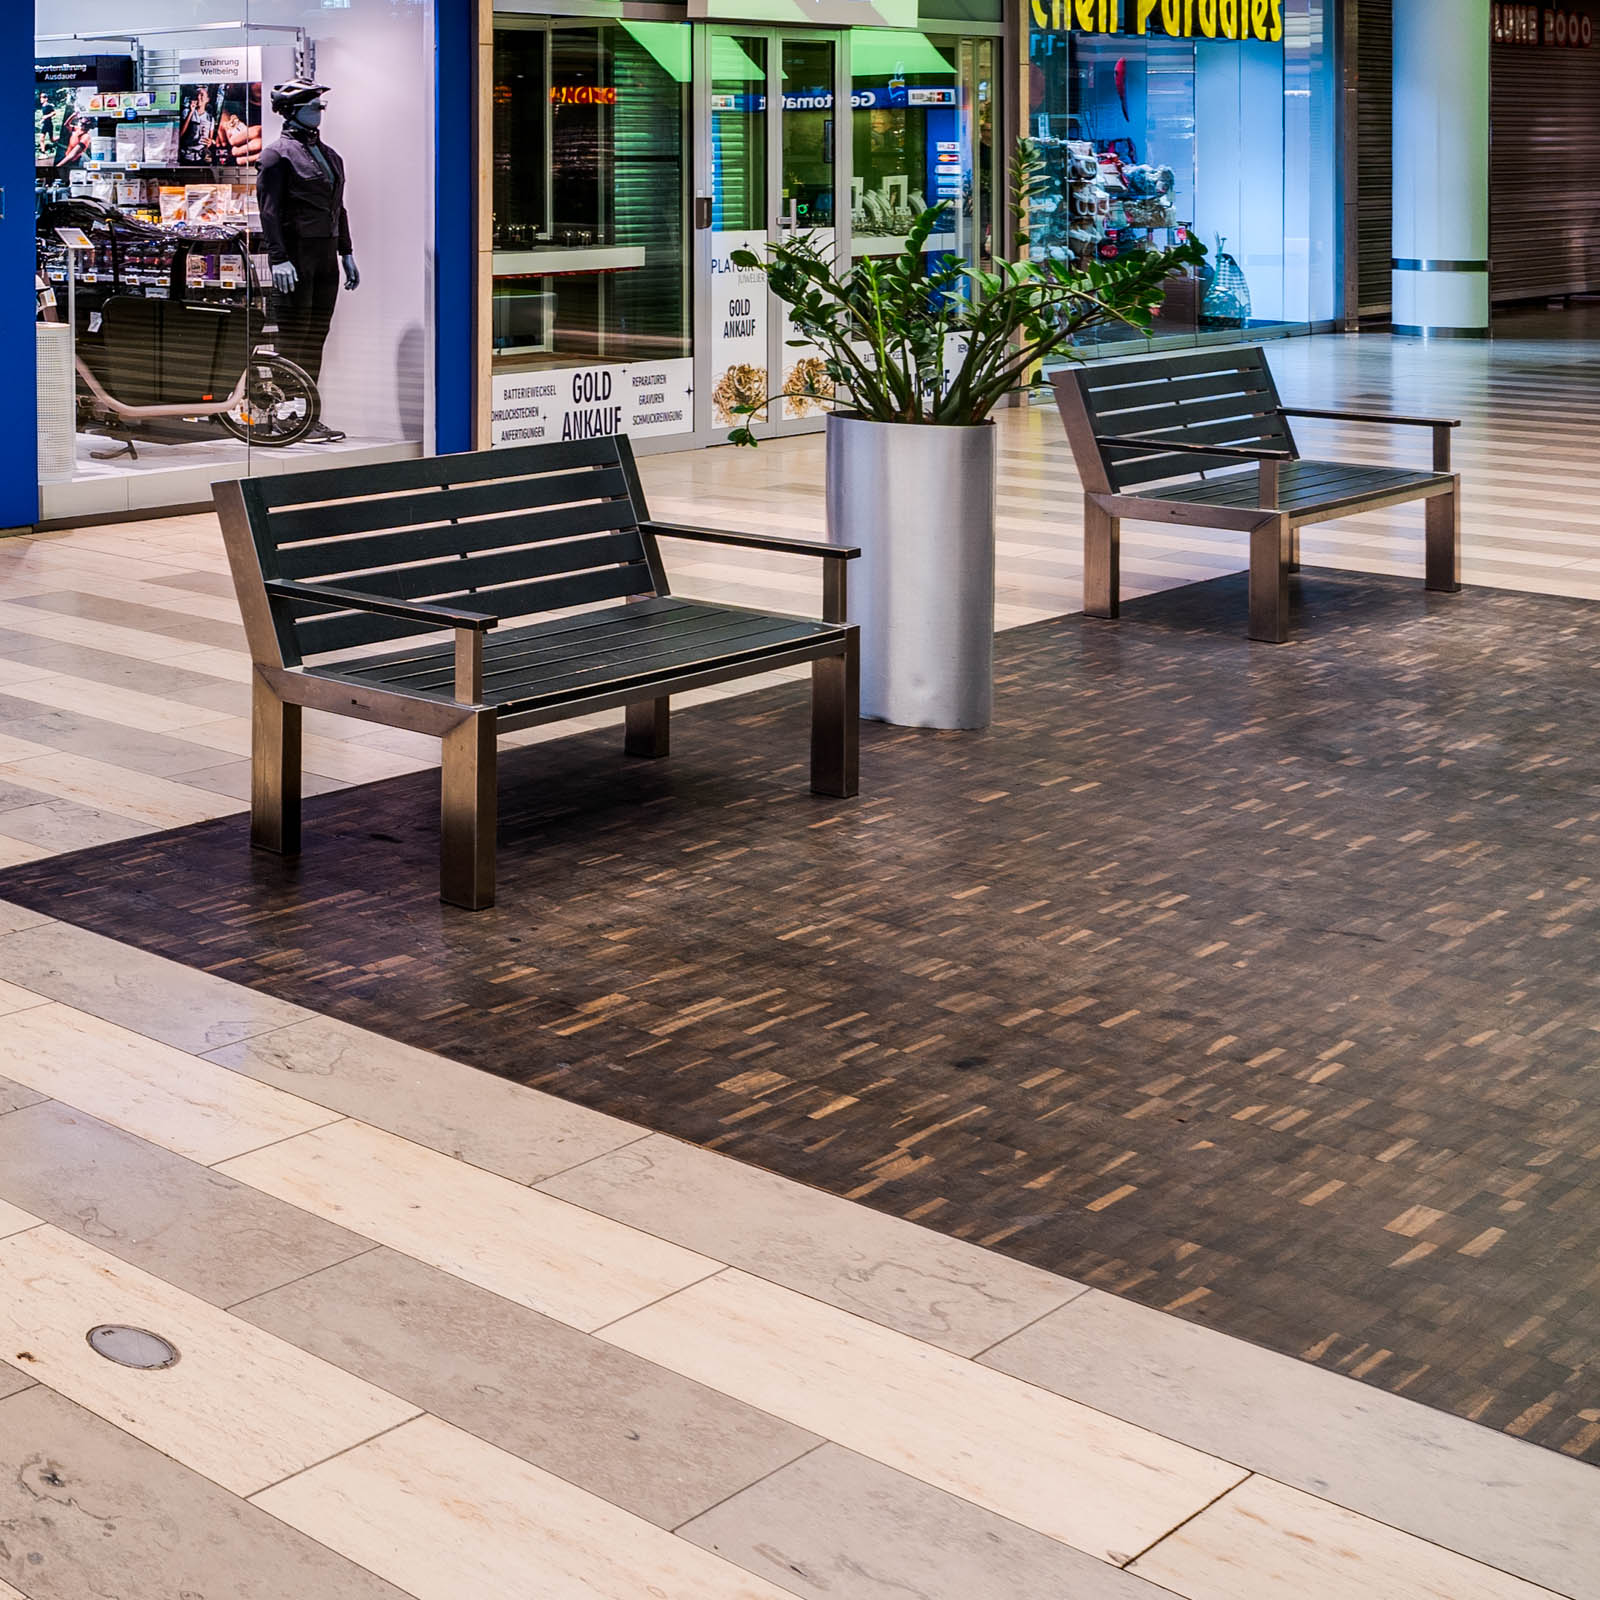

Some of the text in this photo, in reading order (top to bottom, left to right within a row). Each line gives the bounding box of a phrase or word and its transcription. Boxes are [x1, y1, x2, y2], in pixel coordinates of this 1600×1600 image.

[1494, 3, 1592, 47] LUME 2000
[199, 58, 240, 71] Ernährung
[200, 67, 239, 77] Wellbeing
[44, 72, 77, 80] Ausdauer
[729, 299, 751, 317] GOLD
[724, 320, 756, 338] ANKAUF
[572, 371, 612, 404] GOLD
[632, 374, 667, 387] REPARATUREN
[503, 385, 557, 401] BATTERIEWECHSEL
[639, 392, 664, 406] GRAVUREN
[562, 406, 622, 441] ANKAUF
[632, 410, 683, 426] SCHMUCKREINIGUNG
[501, 426, 545, 442] ANFERTIGUNGEN
